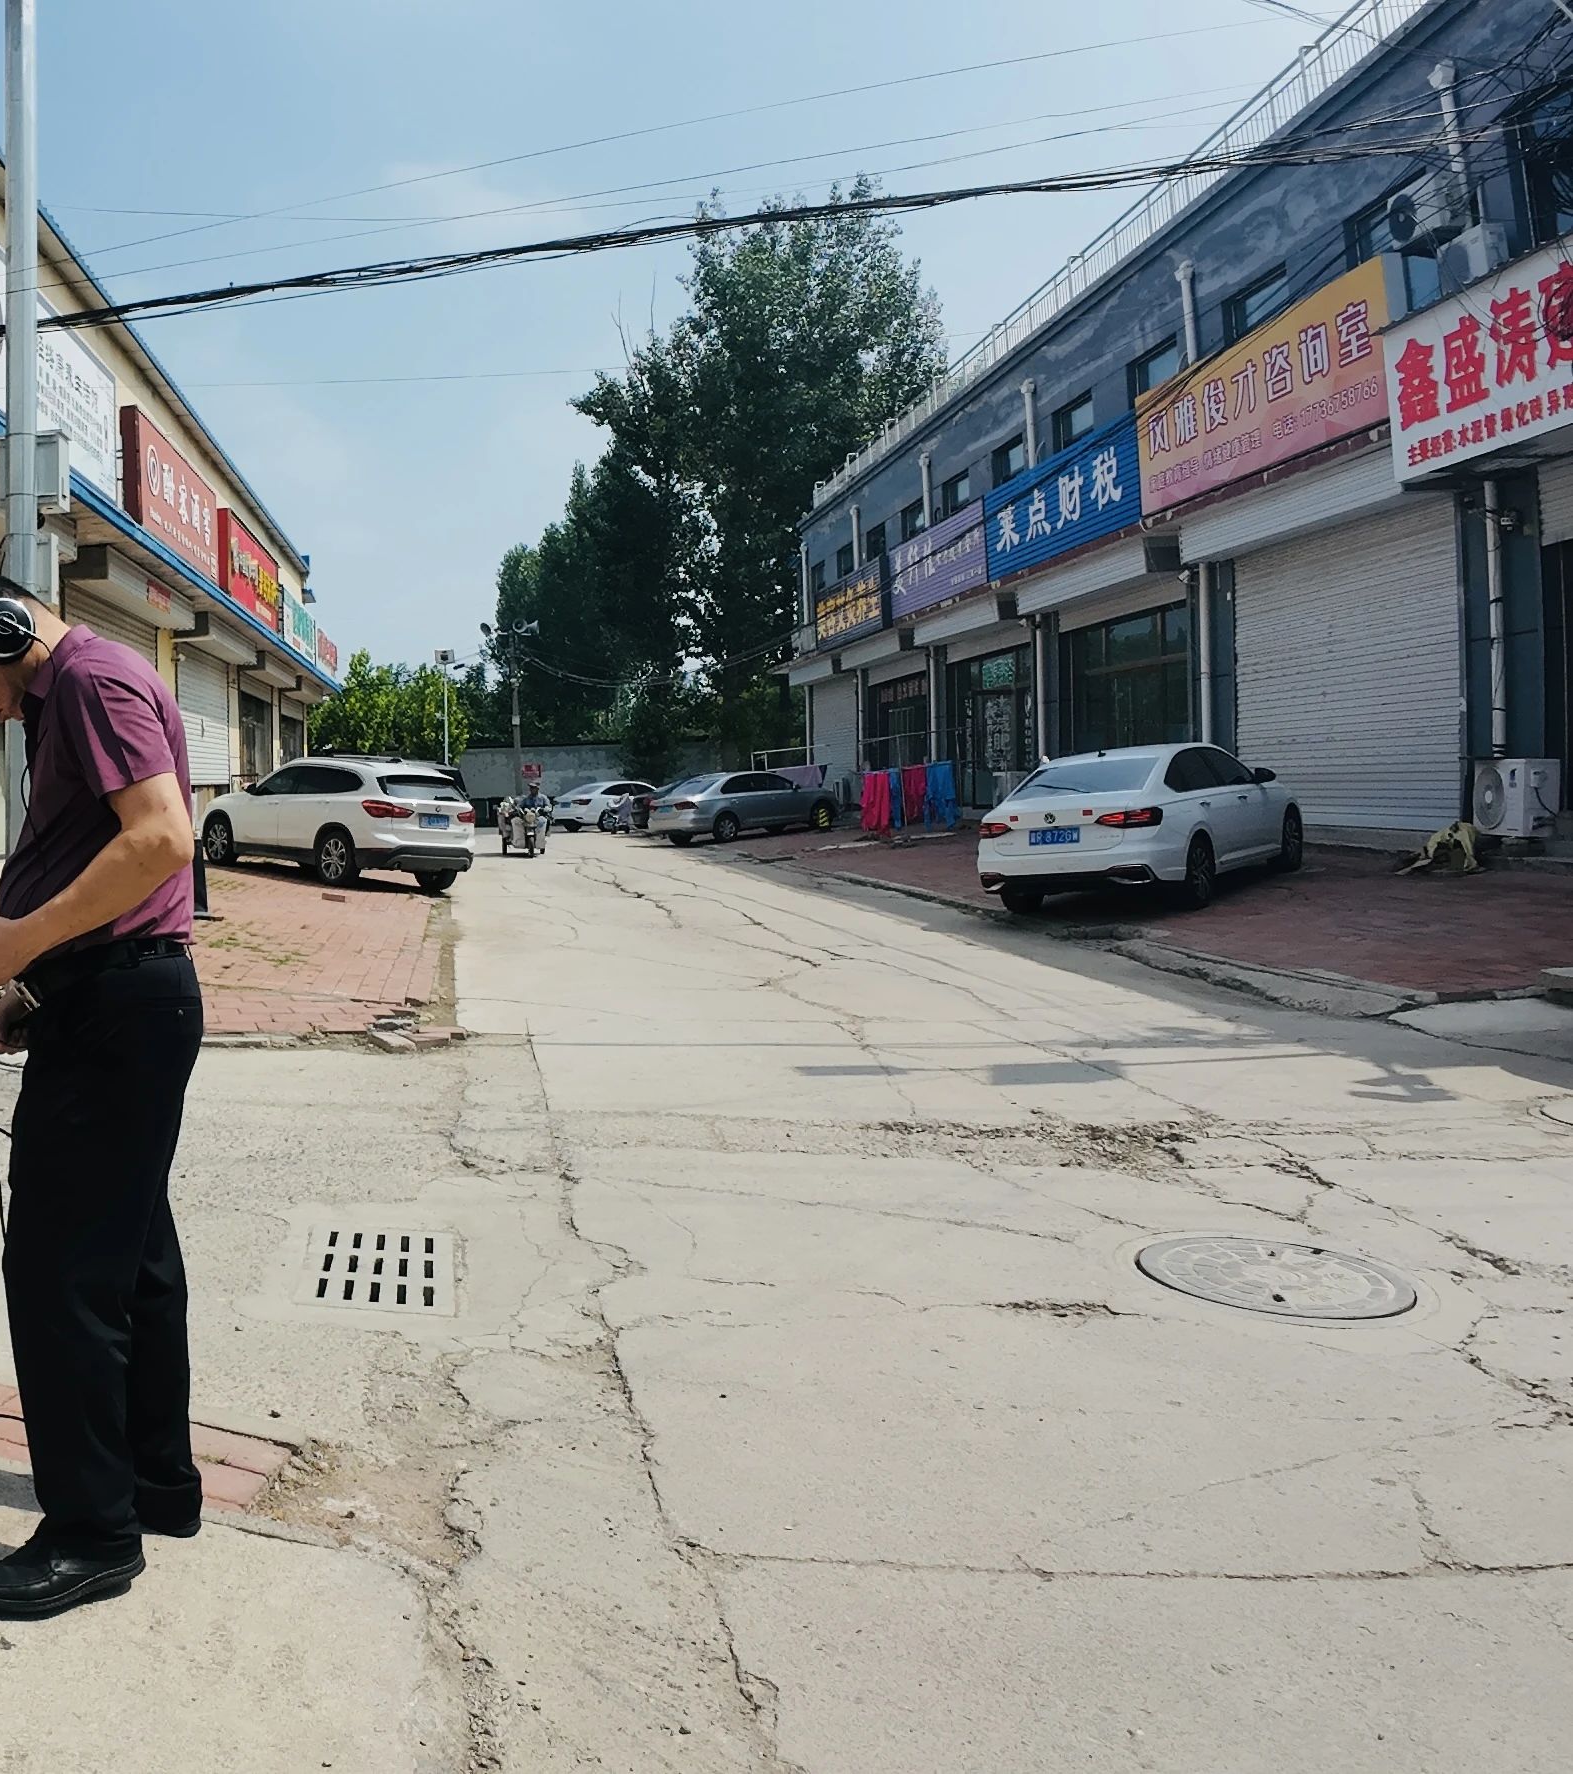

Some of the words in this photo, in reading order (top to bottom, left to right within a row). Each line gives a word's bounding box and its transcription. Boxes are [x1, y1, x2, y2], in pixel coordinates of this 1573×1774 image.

[1149, 299, 1373, 460] 风雅俊才咨询室
